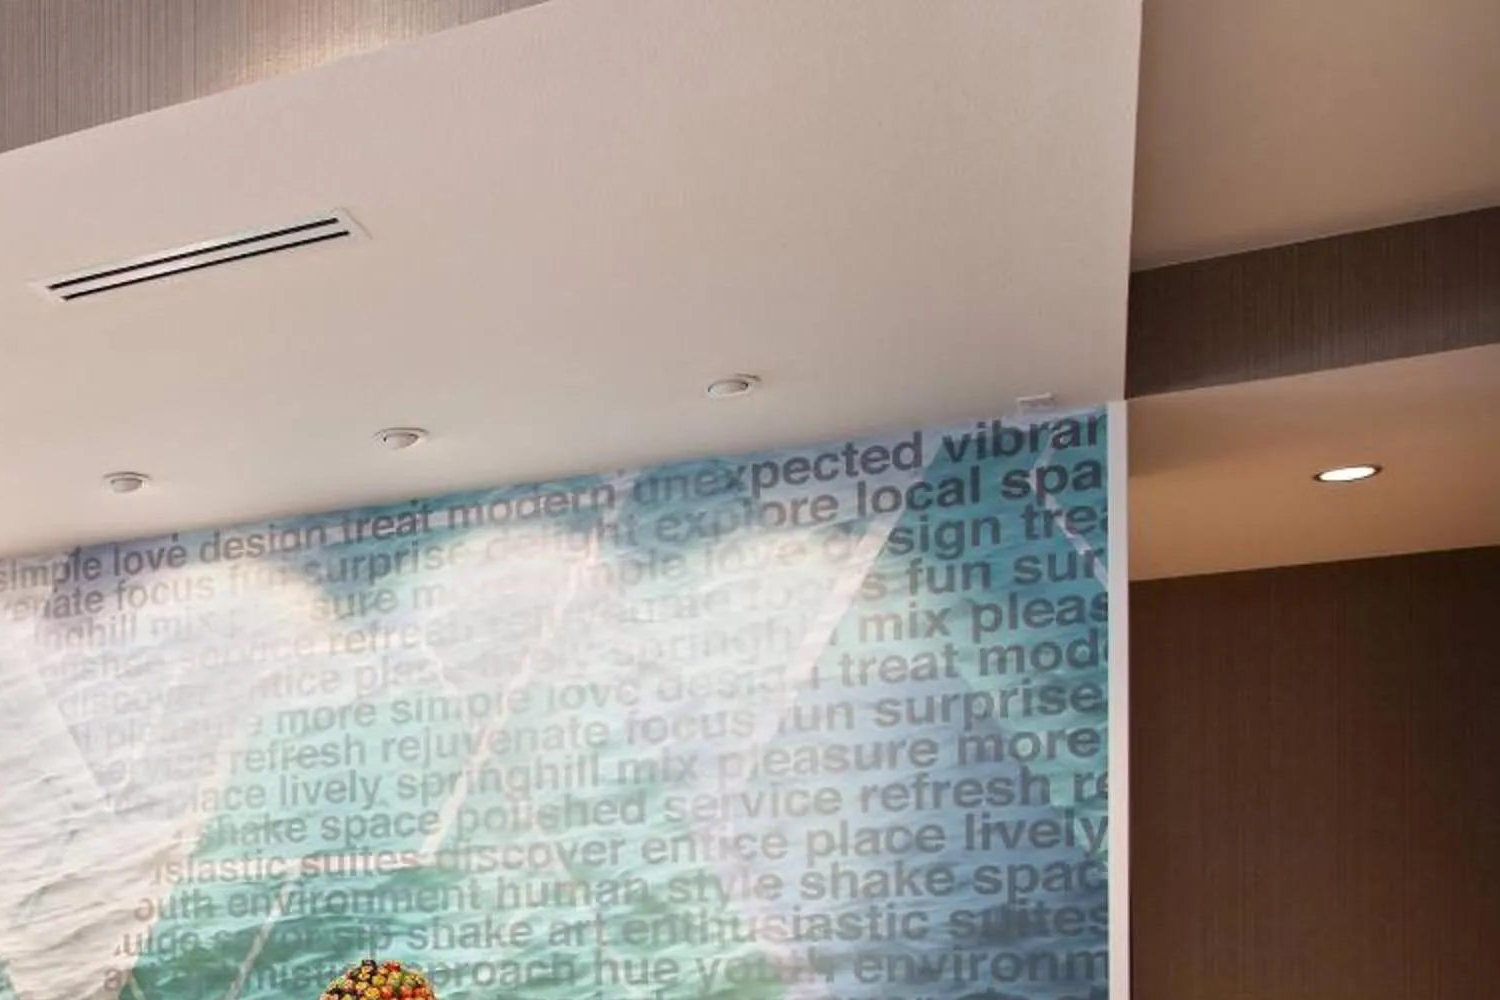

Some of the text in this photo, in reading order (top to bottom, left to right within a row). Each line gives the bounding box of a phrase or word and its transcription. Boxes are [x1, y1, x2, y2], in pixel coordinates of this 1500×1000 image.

[113, 541, 187, 575] love
[199, 520, 326, 564] design
[343, 501, 430, 544] treat
[448, 481, 615, 530] modern
[633, 428, 921, 506] unexpected
[117, 573, 214, 609] focus
[657, 492, 839, 546] explore
[856, 463, 980, 518] local
[1001, 457, 1103, 507] spa
[1021, 501, 1107, 541] tre
[906, 555, 990, 597] fun
[1015, 546, 1105, 586] sur
[859, 598, 952, 644] mix
[277, 700, 376, 734] more
[390, 679, 531, 728] simple
[548, 674, 641, 711] love
[838, 641, 960, 687] treat
[980, 626, 1107, 676] mod
[231, 729, 365, 773] refresh
[381, 715, 609, 769] rejuvenate
[627, 707, 756, 745] focus
[874, 674, 1103, 731] surprise
[192, 778, 267, 811] lace
[278, 767, 381, 810] lively
[396, 750, 598, 806] springhill
[616, 744, 697, 785] mix
[958, 724, 1100, 764] more
[196, 808, 307, 847] shake
[320, 808, 440, 848] space
[457, 786, 645, 842] polished
[663, 778, 842, 822] service
[859, 761, 1052, 812] refresh
[300, 841, 425, 878] suites
[438, 835, 625, 872] discover
[641, 822, 789, 864] entice
[806, 816, 947, 867] place
[965, 804, 1107, 856] lively
[226, 876, 484, 917] environment
[498, 871, 650, 908] human
[666, 862, 783, 911] style
[799, 855, 957, 898] shake
[408, 910, 533, 948] shake
[548, 911, 609, 945] art
[622, 898, 929, 944] enthusiastic
[947, 894, 1107, 936] suites
[595, 946, 679, 983] hue
